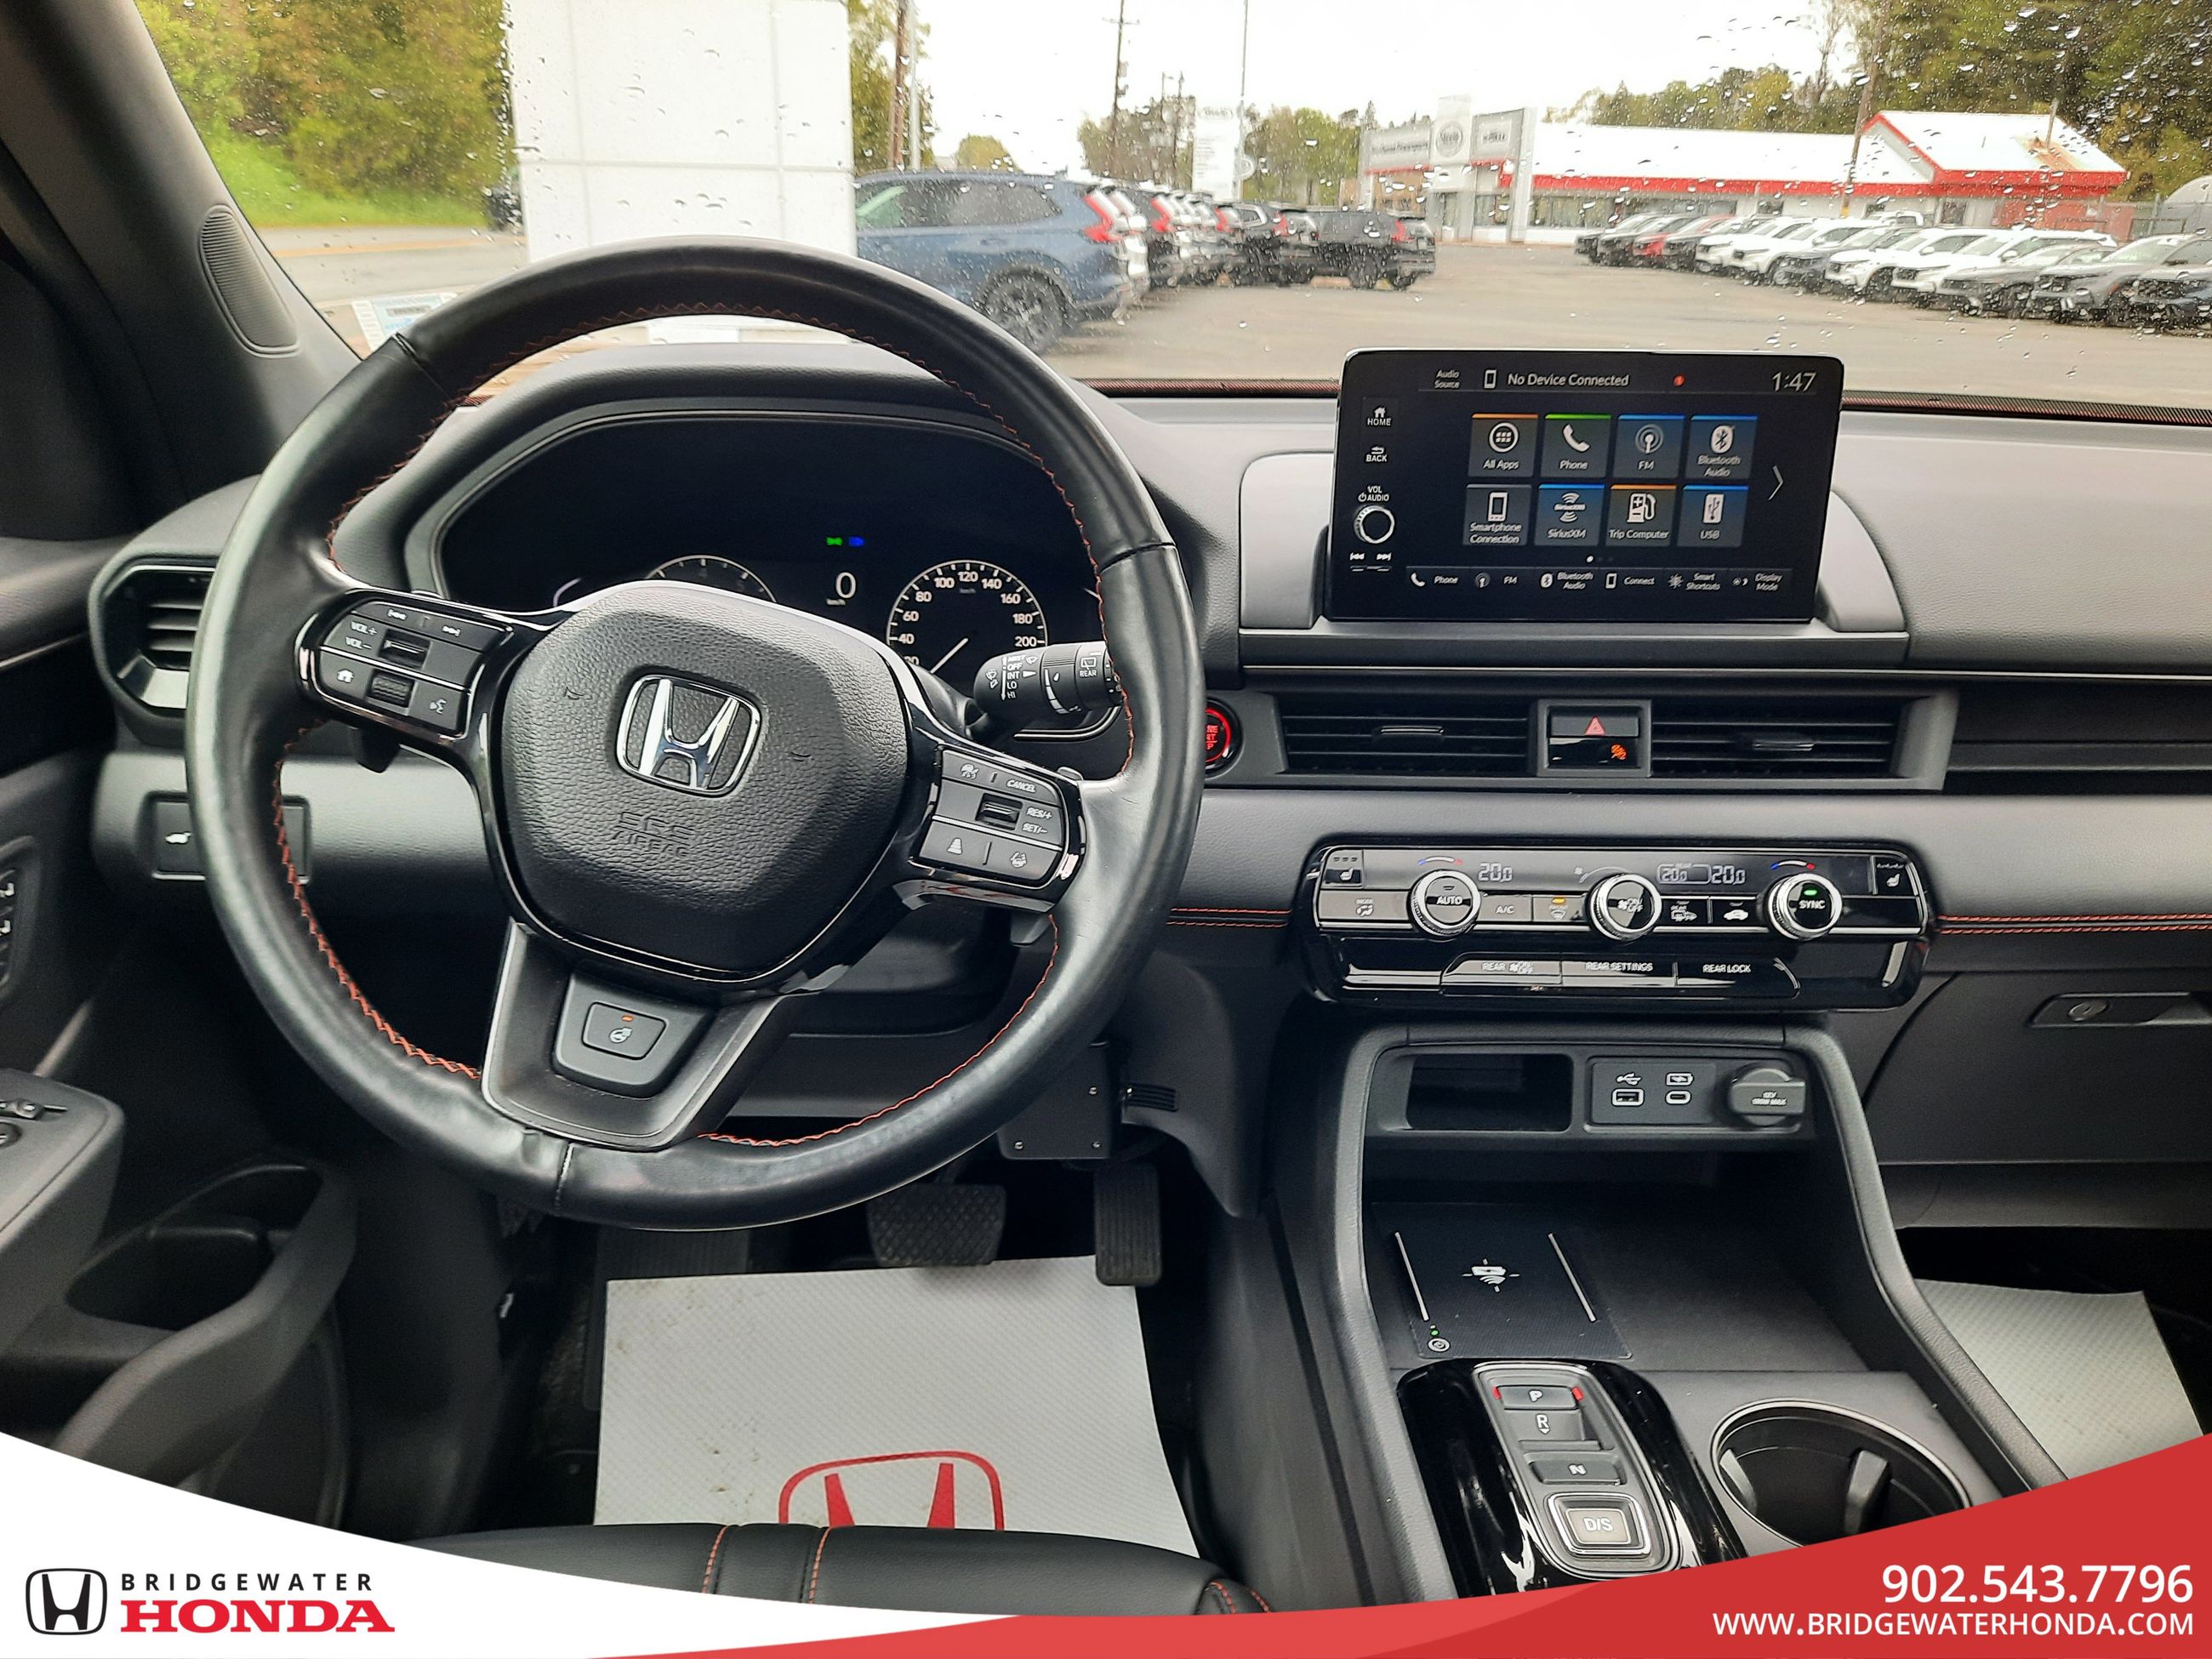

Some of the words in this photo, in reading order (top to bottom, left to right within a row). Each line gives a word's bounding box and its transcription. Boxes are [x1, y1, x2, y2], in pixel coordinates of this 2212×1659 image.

[1435, 369, 1460, 379] Audio
[1434, 379, 1461, 389] Source
[1508, 373, 1525, 385] No
[1527, 373, 1567, 386] Device
[1568, 373, 1630, 387] Connected
[1771, 372, 1817, 392] 1:47
[1367, 418, 1392, 426] HOME
[1365, 453, 1388, 462] BACK
[1697, 454, 1742, 465] Bluetooth
[1483, 459, 1496, 470] All
[1497, 459, 1519, 471] Apps
[1559, 459, 1588, 470] Phone
[1638, 460, 1655, 470] FM
[1704, 467, 1731, 477] Audio
[1366, 493, 1390, 502] AUDIO
[1469, 522, 1522, 533] Smartphone
[1547, 527, 1587, 539] SiriusXM
[1469, 534, 1520, 544] Connection
[1609, 528, 1625, 540] Trip
[1626, 528, 1670, 540] Computer
[1700, 530, 1720, 539] USB
[958, 571, 978, 583] 120
[1434, 575, 1458, 584] Phone
[1503, 575, 1518, 584] FM
[1557, 572, 1593, 581] Bluetooth
[1623, 576, 1656, 585] Connect
[1754, 573, 1783, 584] Display
[835, 572, 858, 599] 0
[934, 577, 955, 589] 100
[982, 579, 1002, 590] 140
[1563, 581, 1586, 590] Audio
[1756, 583, 1779, 591] Mode
[915, 590, 932, 602] 80
[1001, 593, 1022, 605] 160
[902, 611, 920, 622] 60
[1012, 613, 1034, 625] 180
[898, 633, 915, 645] 40
[1014, 636, 1037, 647] 200
[1006, 662, 1023, 671] OFF
[1006, 671, 1020, 680] INT
[1006, 680, 1018, 689] LO
[1006, 779, 1036, 793] CANCEL
[1026, 807, 1052, 819] RES/+
[1436, 895, 1463, 905] AUTO
[1799, 899, 1827, 909] SYNC
[1496, 904, 1516, 915] A/C
[1585, 961, 1610, 971] REAR
[1610, 962, 1654, 972] SETTINGS
[1702, 964, 1726, 973] REAR
[1726, 964, 1751, 973] LOCK
[1529, 1389, 1542, 1402] P
[1536, 1414, 1549, 1428] R
[1569, 1465, 1587, 1475] N
[1584, 1516, 1613, 1531] D/S
